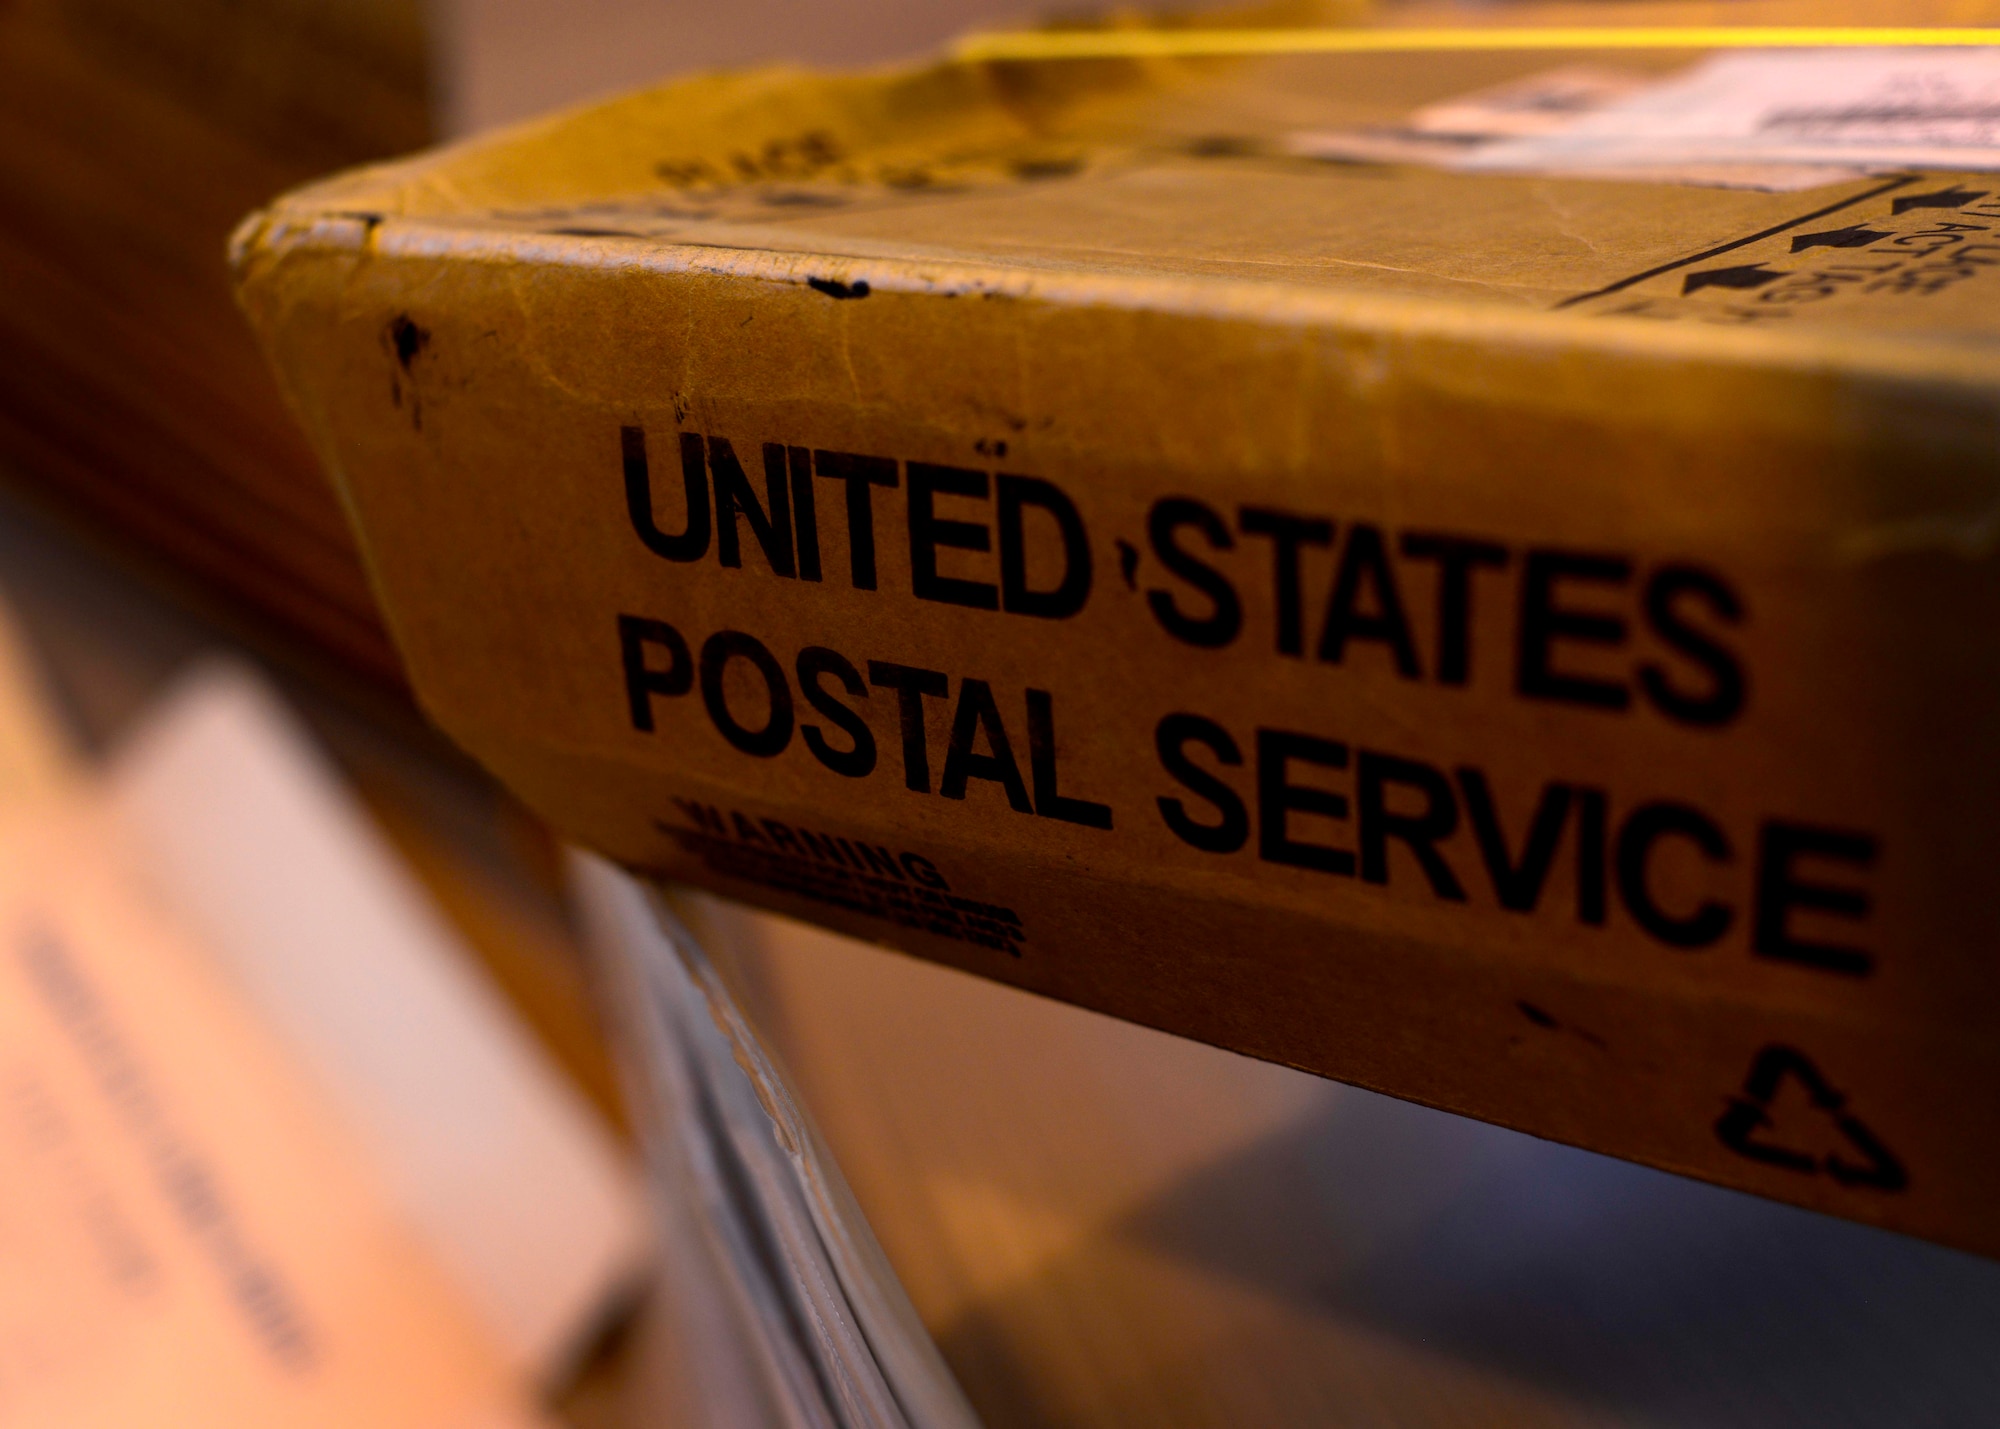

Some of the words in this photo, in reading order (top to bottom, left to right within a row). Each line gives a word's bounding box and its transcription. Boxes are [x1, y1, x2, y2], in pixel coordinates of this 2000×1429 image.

[621, 426, 1093, 620] UNITED
[1147, 497, 1748, 728] STATES
[618, 614, 1114, 831] POSTAL
[1155, 712, 1879, 978] SERVICE
[671, 795, 949, 892] WARNING
